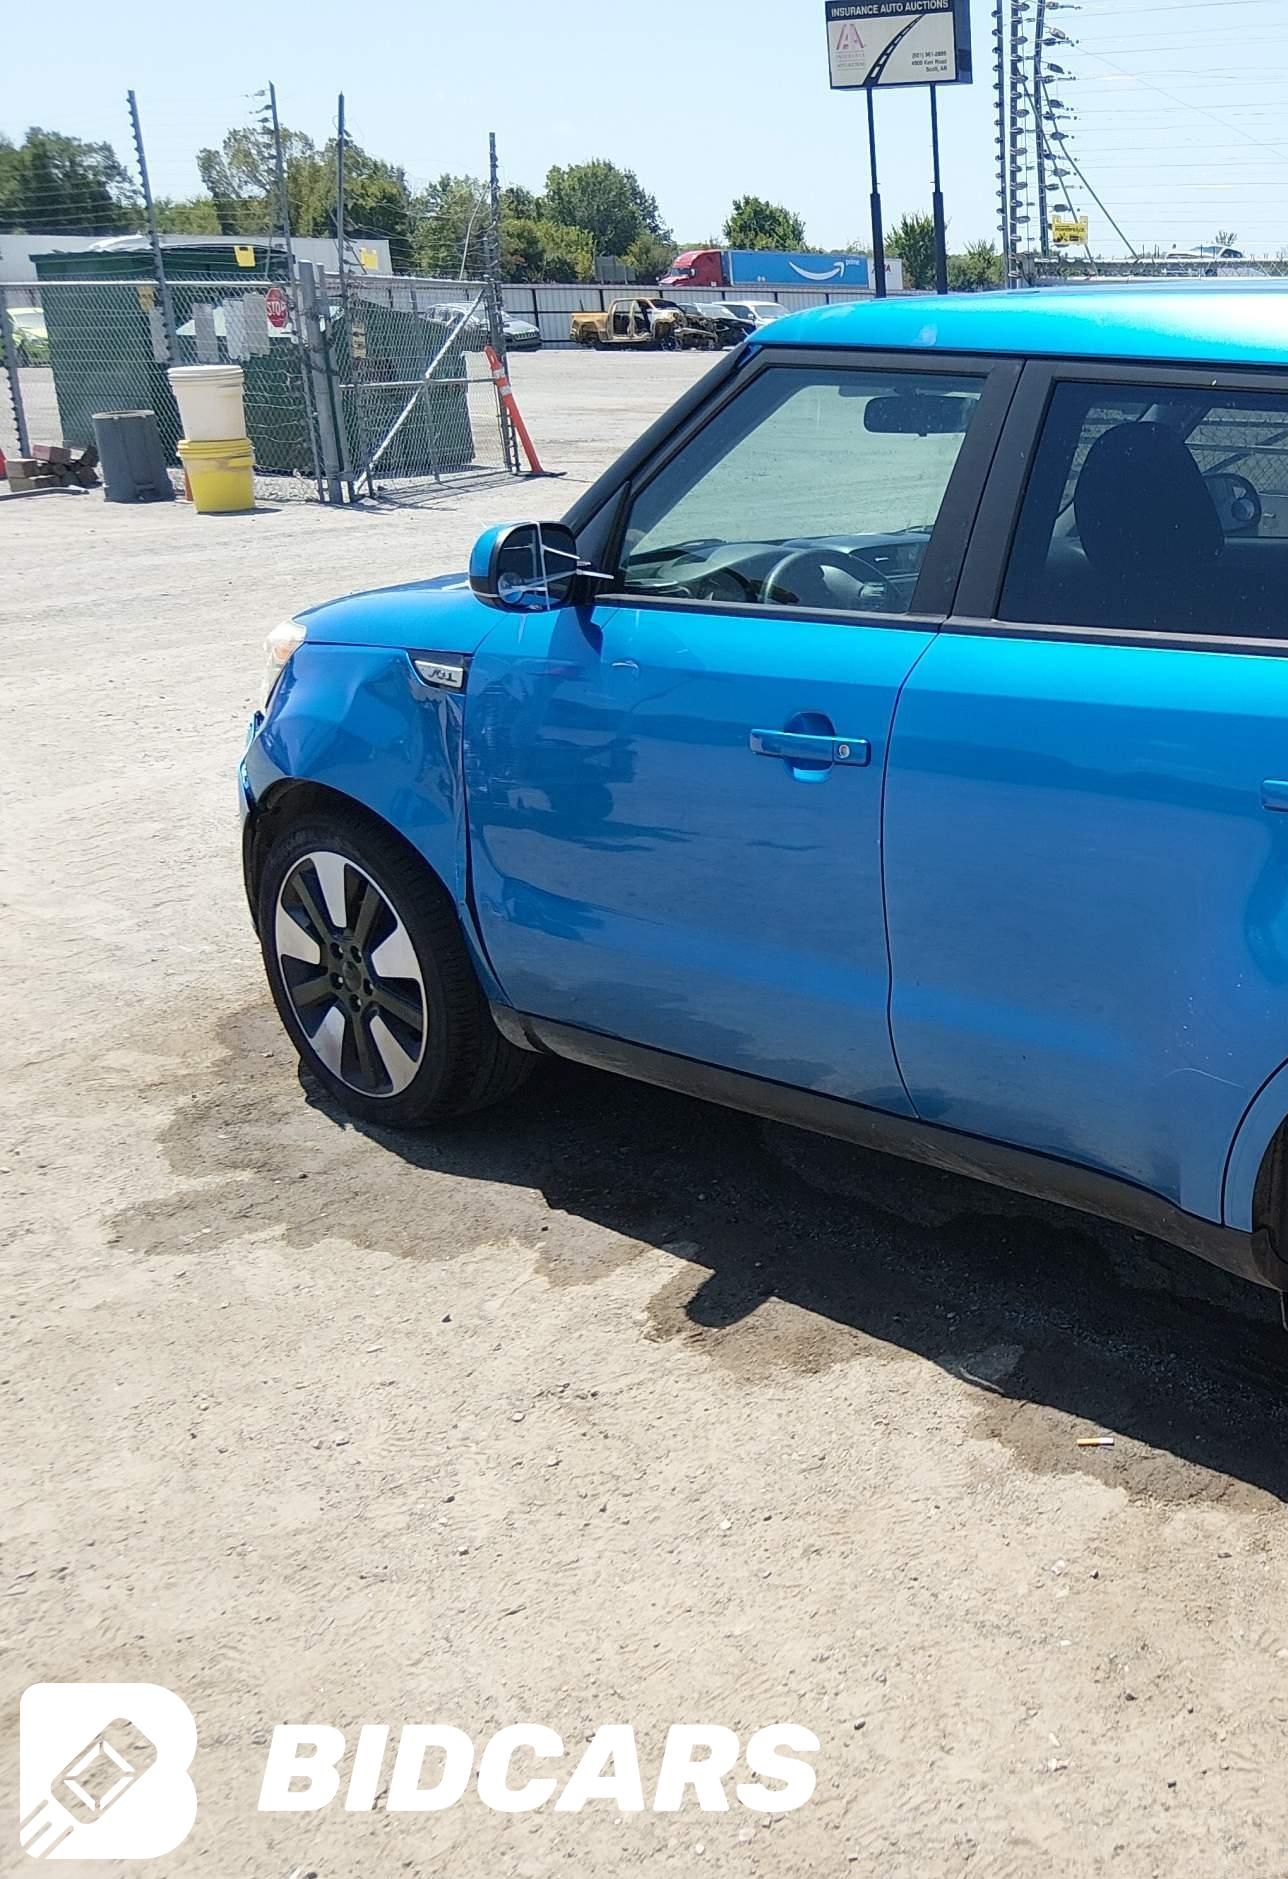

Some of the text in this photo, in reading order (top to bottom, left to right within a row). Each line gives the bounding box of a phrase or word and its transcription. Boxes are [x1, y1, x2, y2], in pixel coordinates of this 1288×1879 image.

[831, 0, 949, 17] INSURANCE AUTO AUCTIONS
[267, 301, 286, 316] STOP
